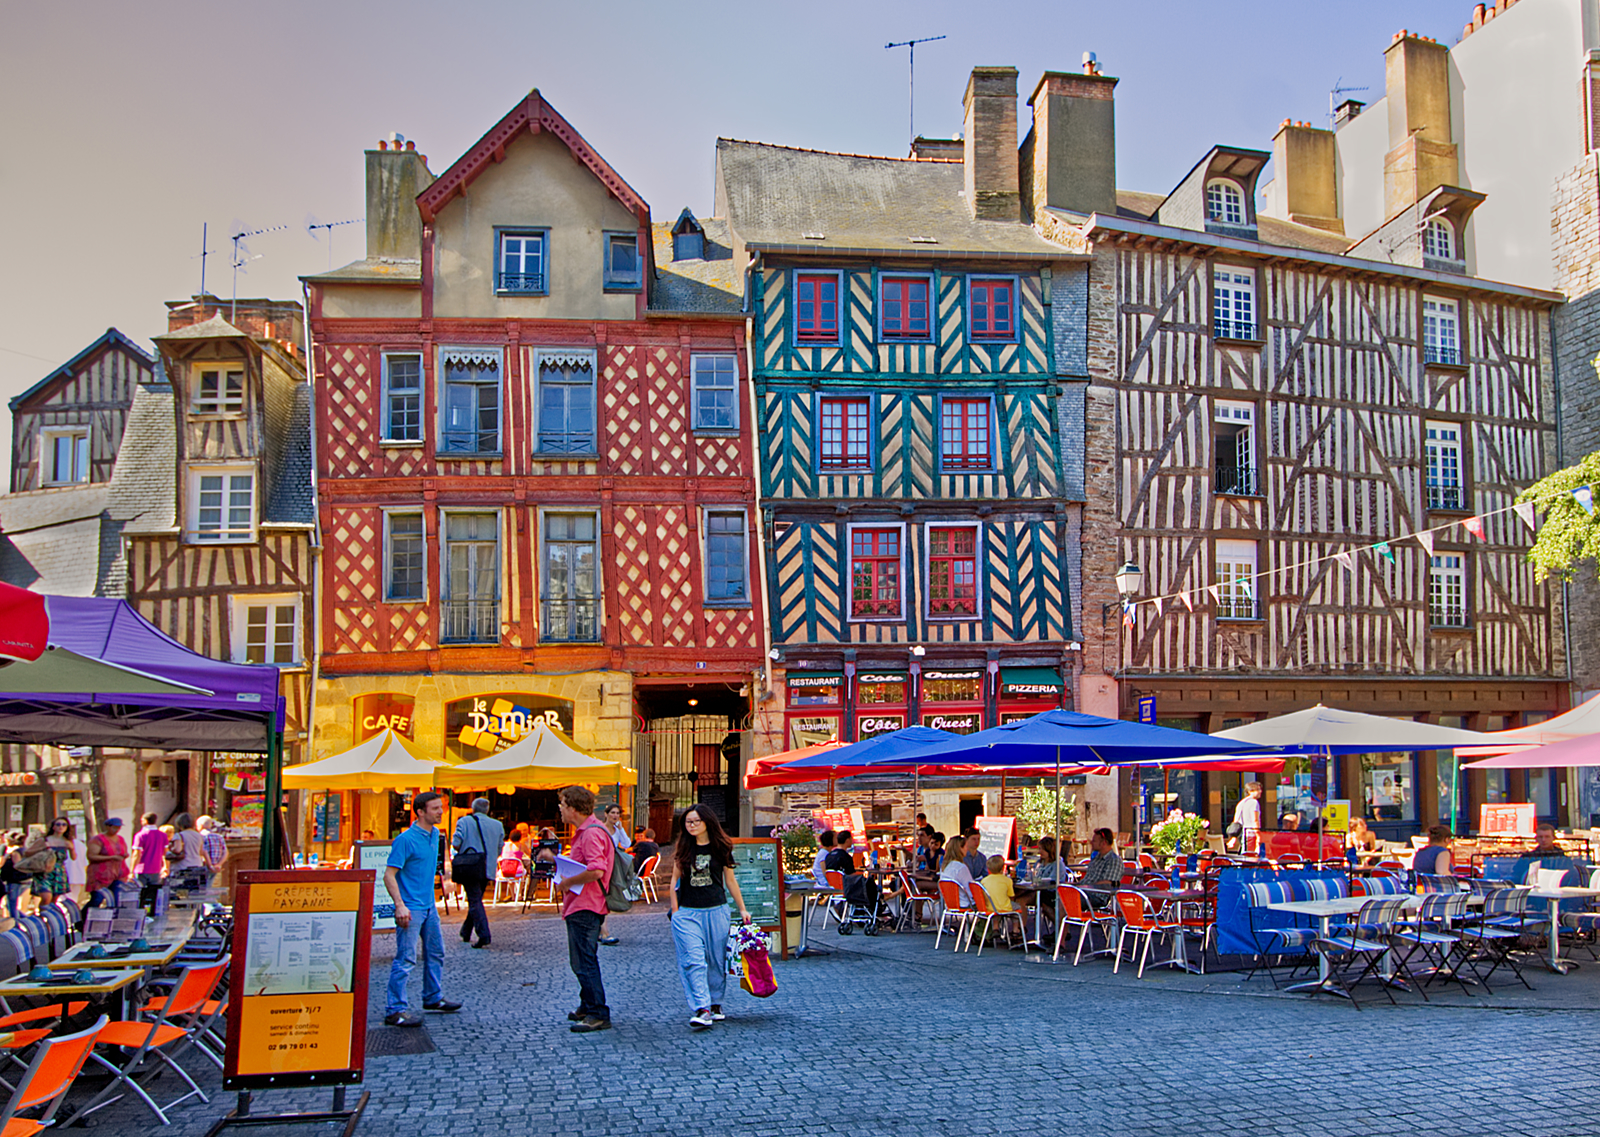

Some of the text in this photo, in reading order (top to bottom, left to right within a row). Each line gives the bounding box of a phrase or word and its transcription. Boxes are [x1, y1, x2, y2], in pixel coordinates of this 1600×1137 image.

[789, 677, 840, 686] RESTAURANT
[1008, 684, 1058, 693] PIZZERIA
[363, 714, 409, 731] CAFE
[792, 723, 836, 731] RESTAURANT
[861, 718, 900, 733] Côte
[930, 717, 973, 730] Ouest
[275, 885, 332, 898] CRÊPERIE
[273, 898, 333, 909] PAYSANNE
